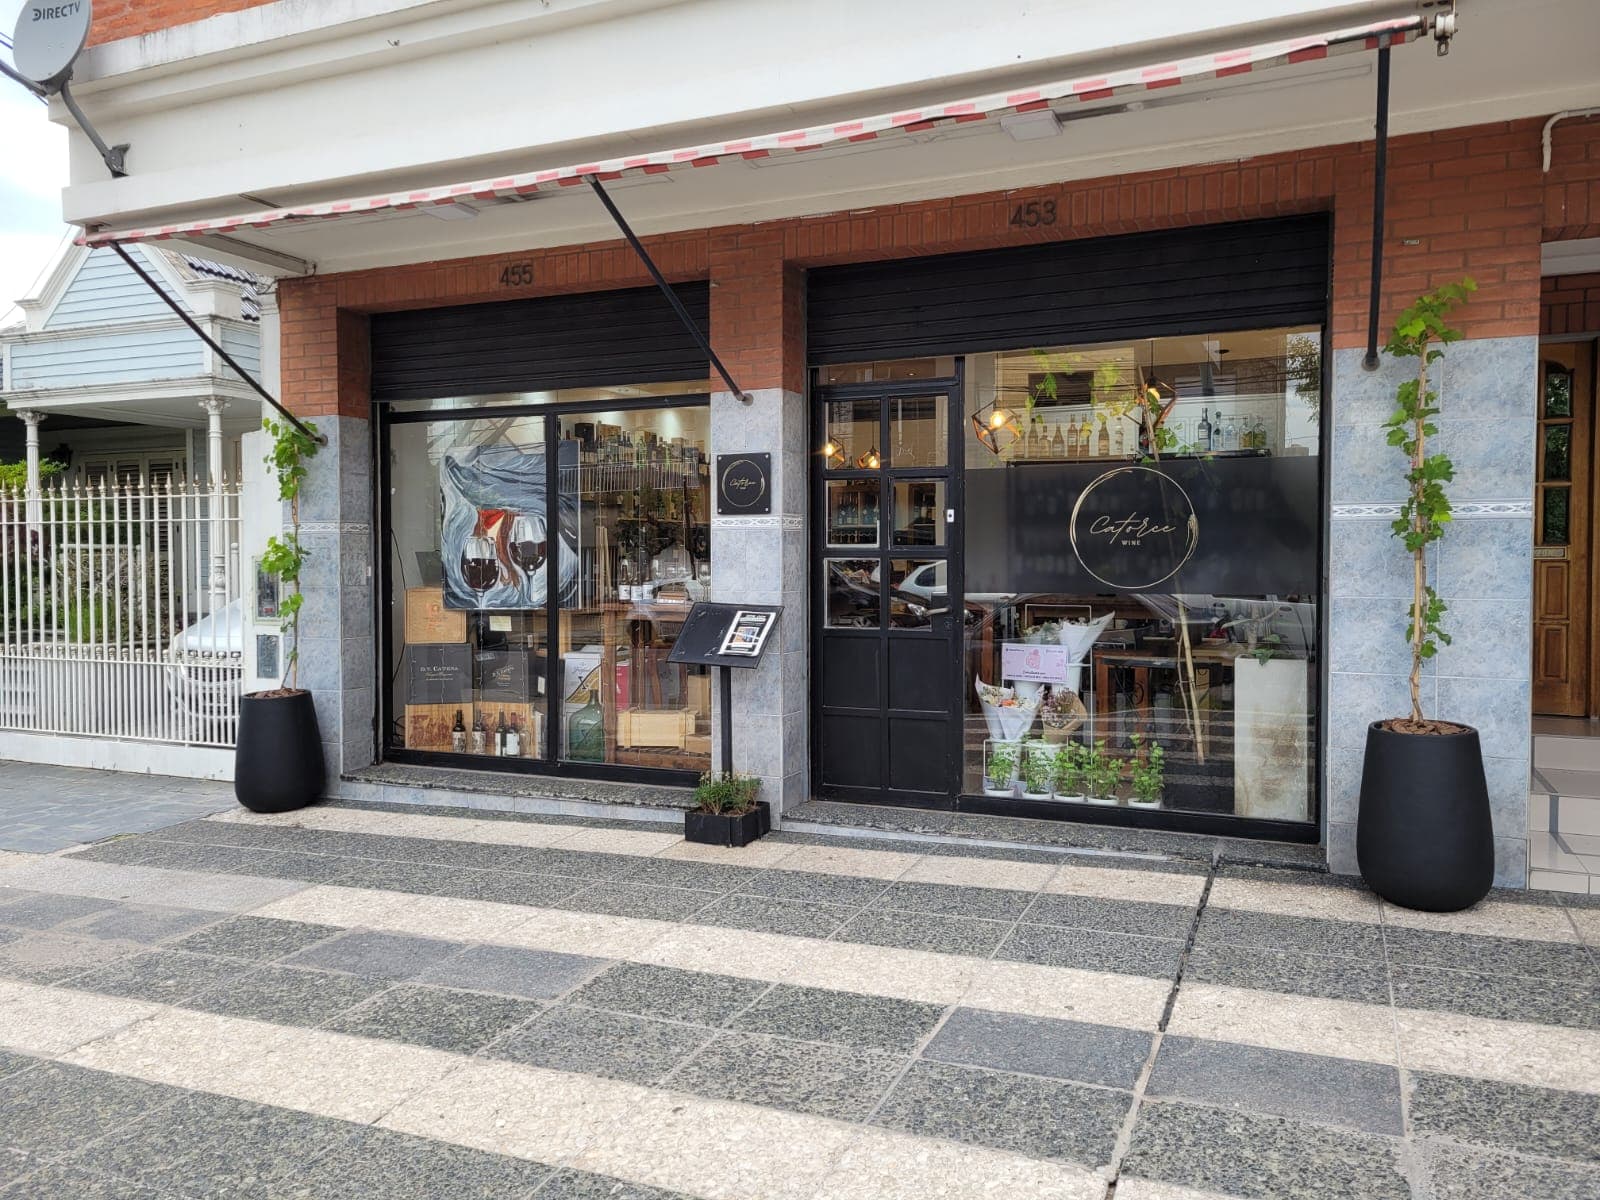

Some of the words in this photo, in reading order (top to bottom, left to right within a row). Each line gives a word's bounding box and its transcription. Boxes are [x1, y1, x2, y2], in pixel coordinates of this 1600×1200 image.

[32, 1, 81, 21] DIRECTV
[1010, 200, 1056, 228] 453
[500, 264, 533, 286] 455
